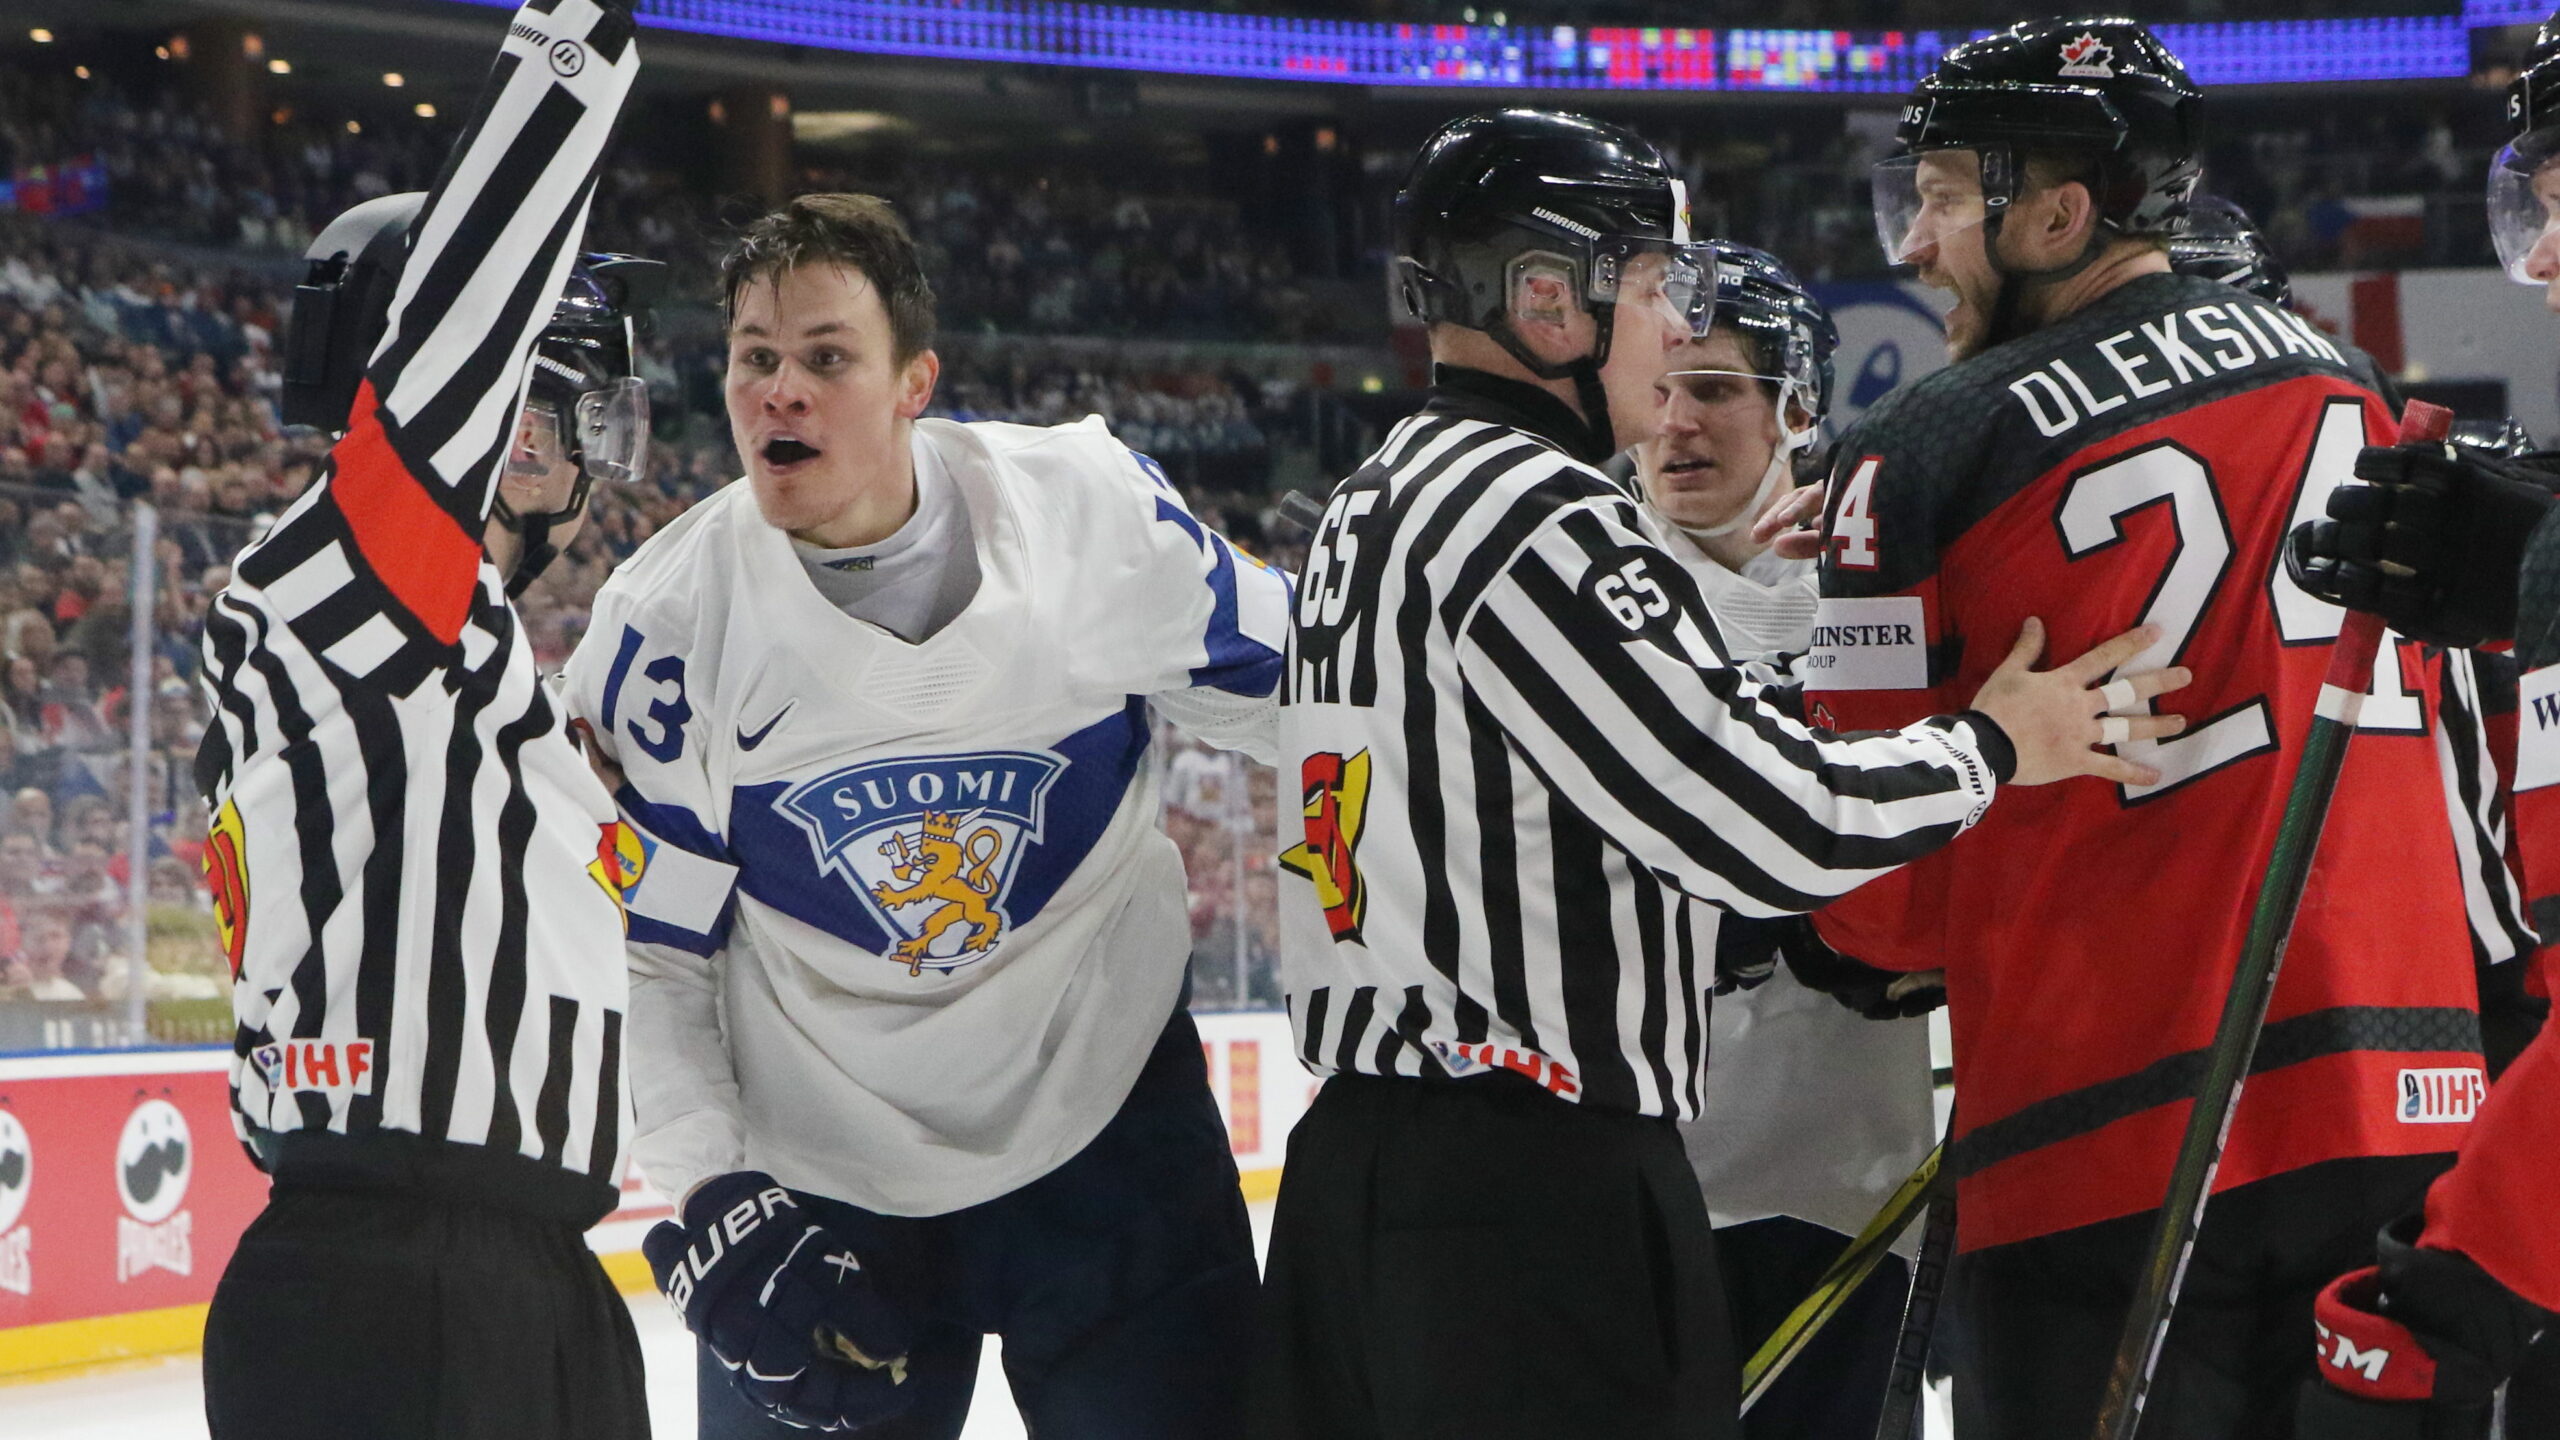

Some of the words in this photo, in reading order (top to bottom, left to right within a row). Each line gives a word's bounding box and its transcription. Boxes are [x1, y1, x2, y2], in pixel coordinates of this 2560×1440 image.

[1900, 105, 1924, 125] US
[1532, 206, 1602, 242] WARRIOR
[2008, 302, 2348, 437] OLEKSIAK
[1300, 489, 1381, 628] 65
[1819, 455, 1881, 571] 4
[1594, 557, 1670, 631] 65
[2053, 396, 2430, 809] 24
[601, 623, 693, 764] 13
[833, 770, 1017, 821] SUOMI
